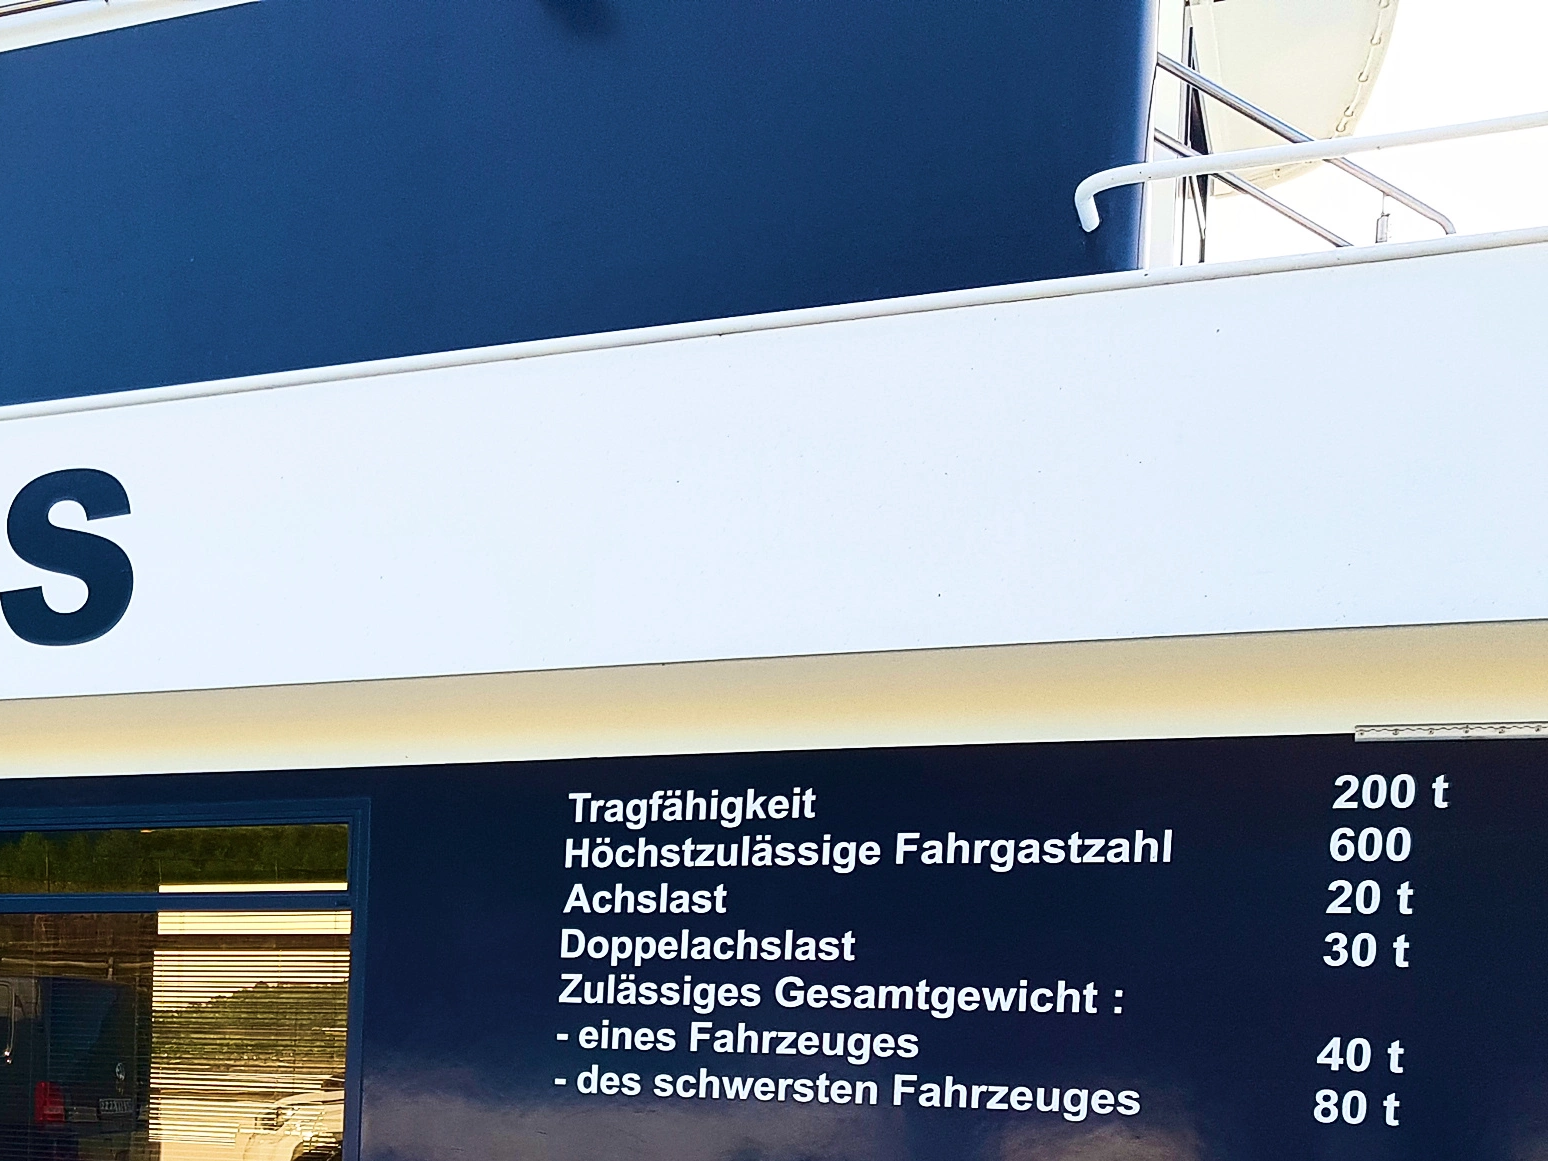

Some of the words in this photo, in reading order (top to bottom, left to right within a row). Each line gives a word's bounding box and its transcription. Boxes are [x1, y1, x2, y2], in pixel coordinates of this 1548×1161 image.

[568, 787, 817, 830] Tragfähigkeit
[1332, 774, 1416, 809] 200
[1431, 774, 1449, 809] t
[564, 834, 881, 874] Höchstzulässige
[895, 829, 1173, 873] Fahrgastzahl
[1329, 826, 1412, 862] 600
[562, 882, 728, 914] Achslast
[1325, 879, 1381, 915] 20
[1396, 880, 1414, 915] t
[560, 928, 856, 967] Doppelachslast
[1322, 932, 1377, 968] 30
[1392, 934, 1410, 968] t
[558, 973, 761, 1015] Zulässiges
[775, 975, 1099, 1019] Gesamtgewicht
[578, 1019, 676, 1052] eines
[689, 1021, 919, 1065] Fahrzeuges
[1316, 1036, 1372, 1073] 40
[1387, 1039, 1405, 1074] t
[576, 1064, 641, 1096] des
[653, 1067, 878, 1105] schwersten
[893, 1073, 1141, 1122] Fahrzeuges
[1313, 1088, 1367, 1125] 80
[1382, 1092, 1400, 1127] t
